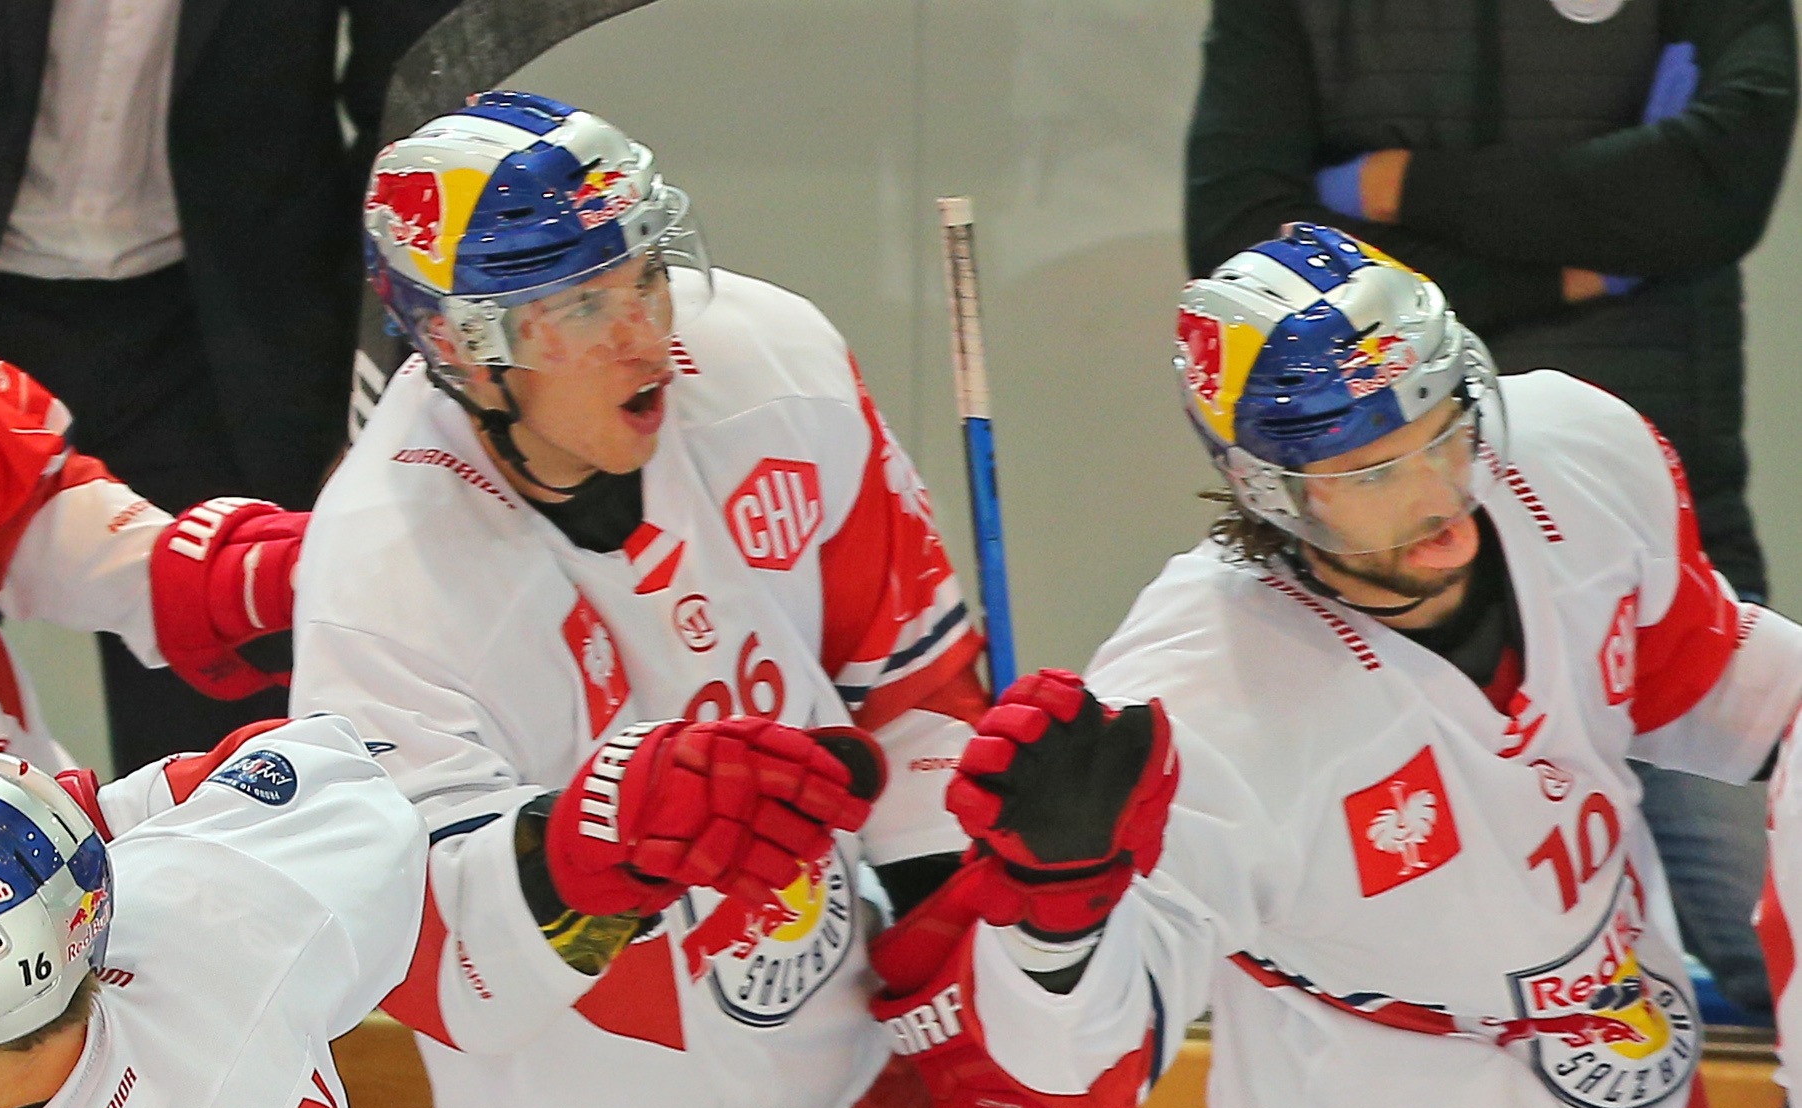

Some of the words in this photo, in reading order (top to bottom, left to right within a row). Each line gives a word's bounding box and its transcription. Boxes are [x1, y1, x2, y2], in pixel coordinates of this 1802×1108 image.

[733, 469, 820, 561] CHL
[1526, 792, 1621, 914] 10
[17, 951, 53, 987] 16
